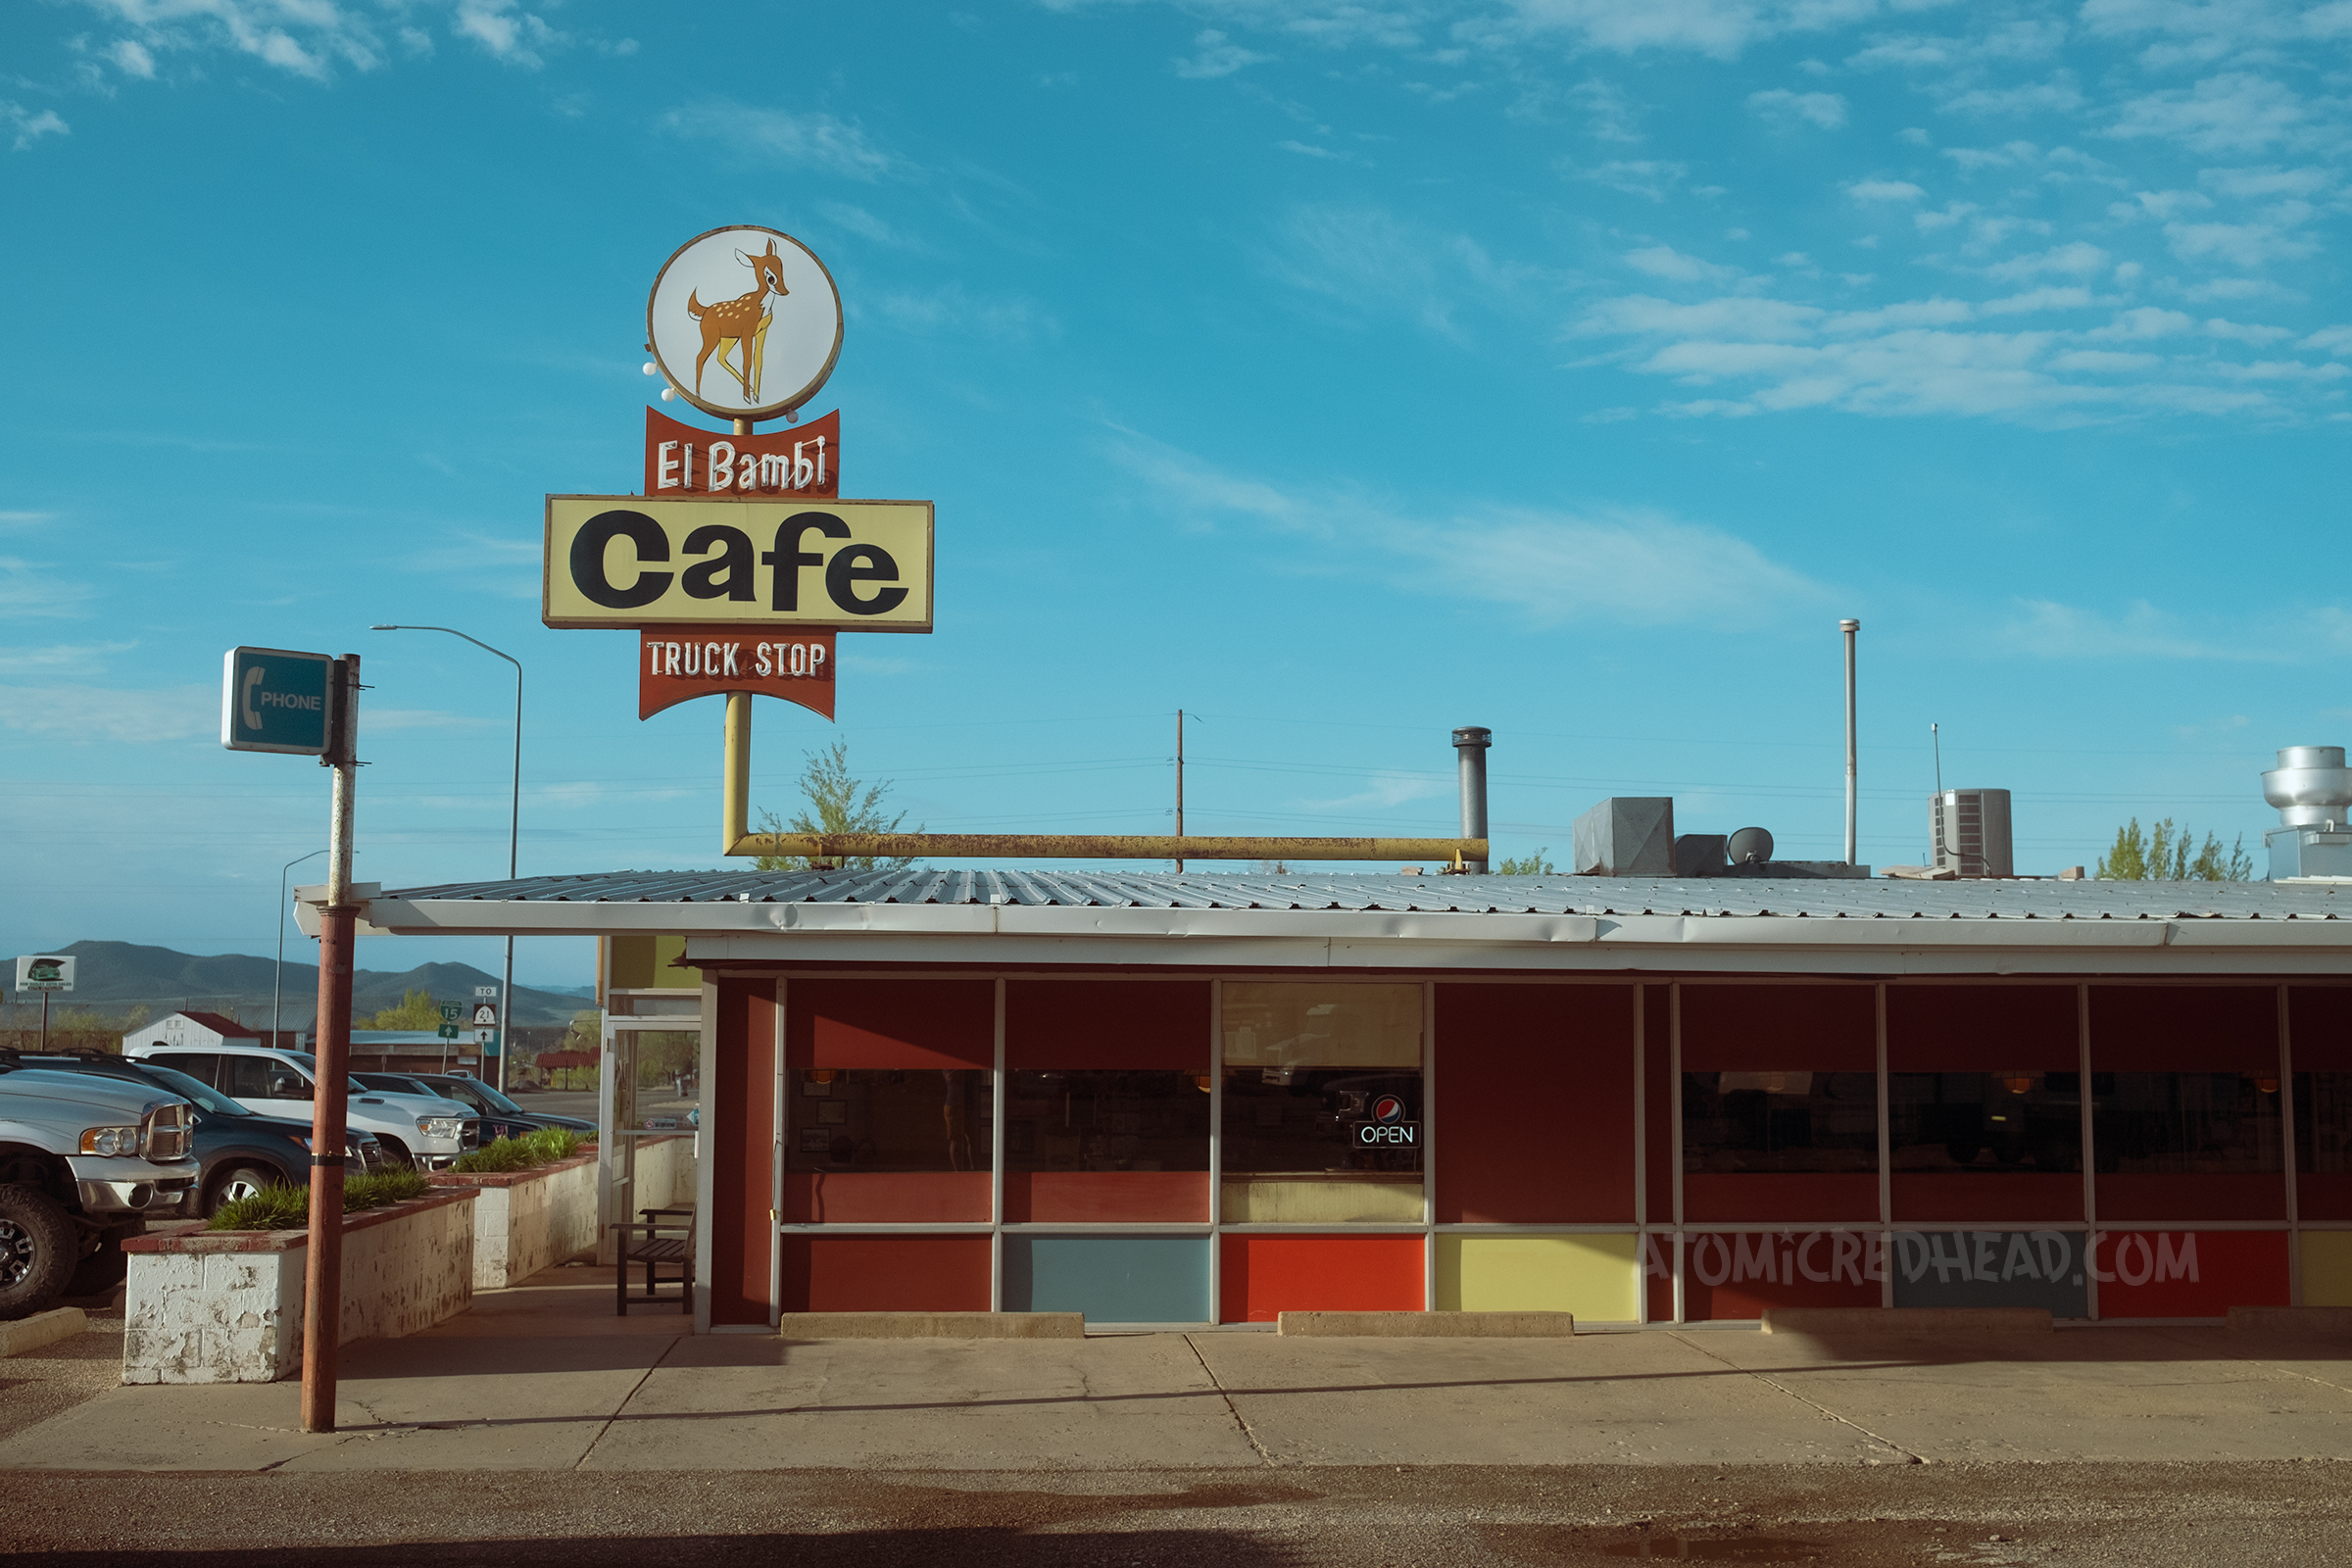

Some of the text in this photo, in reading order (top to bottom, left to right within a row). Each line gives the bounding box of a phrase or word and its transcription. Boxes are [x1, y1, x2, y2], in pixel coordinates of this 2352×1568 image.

[658, 435, 826, 492] El Bambi
[647, 641, 826, 677] TRUCK STOP
[261, 691, 321, 711] PHONE
[445, 1008, 458, 1019] 15
[479, 1009, 490, 1019] 21
[1360, 1126, 1413, 1143] OPEN
